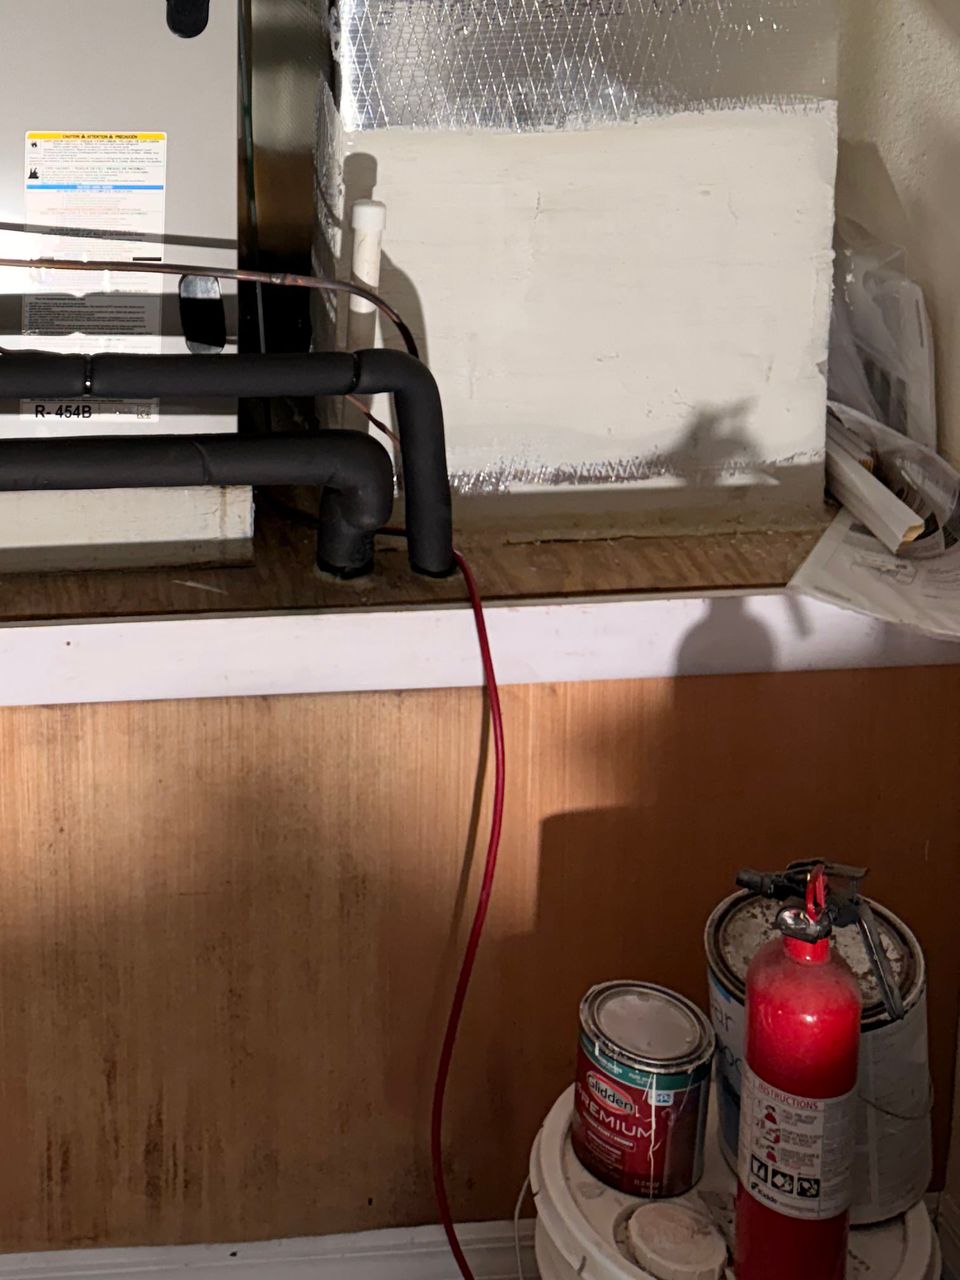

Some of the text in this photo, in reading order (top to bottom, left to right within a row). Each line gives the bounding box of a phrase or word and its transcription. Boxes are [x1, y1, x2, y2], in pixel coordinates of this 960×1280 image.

[35, 405, 92, 418] R- 454B
[587, 1075, 633, 1113] Glidden
[758, 1083, 818, 1110] INSTRUCTIONS
